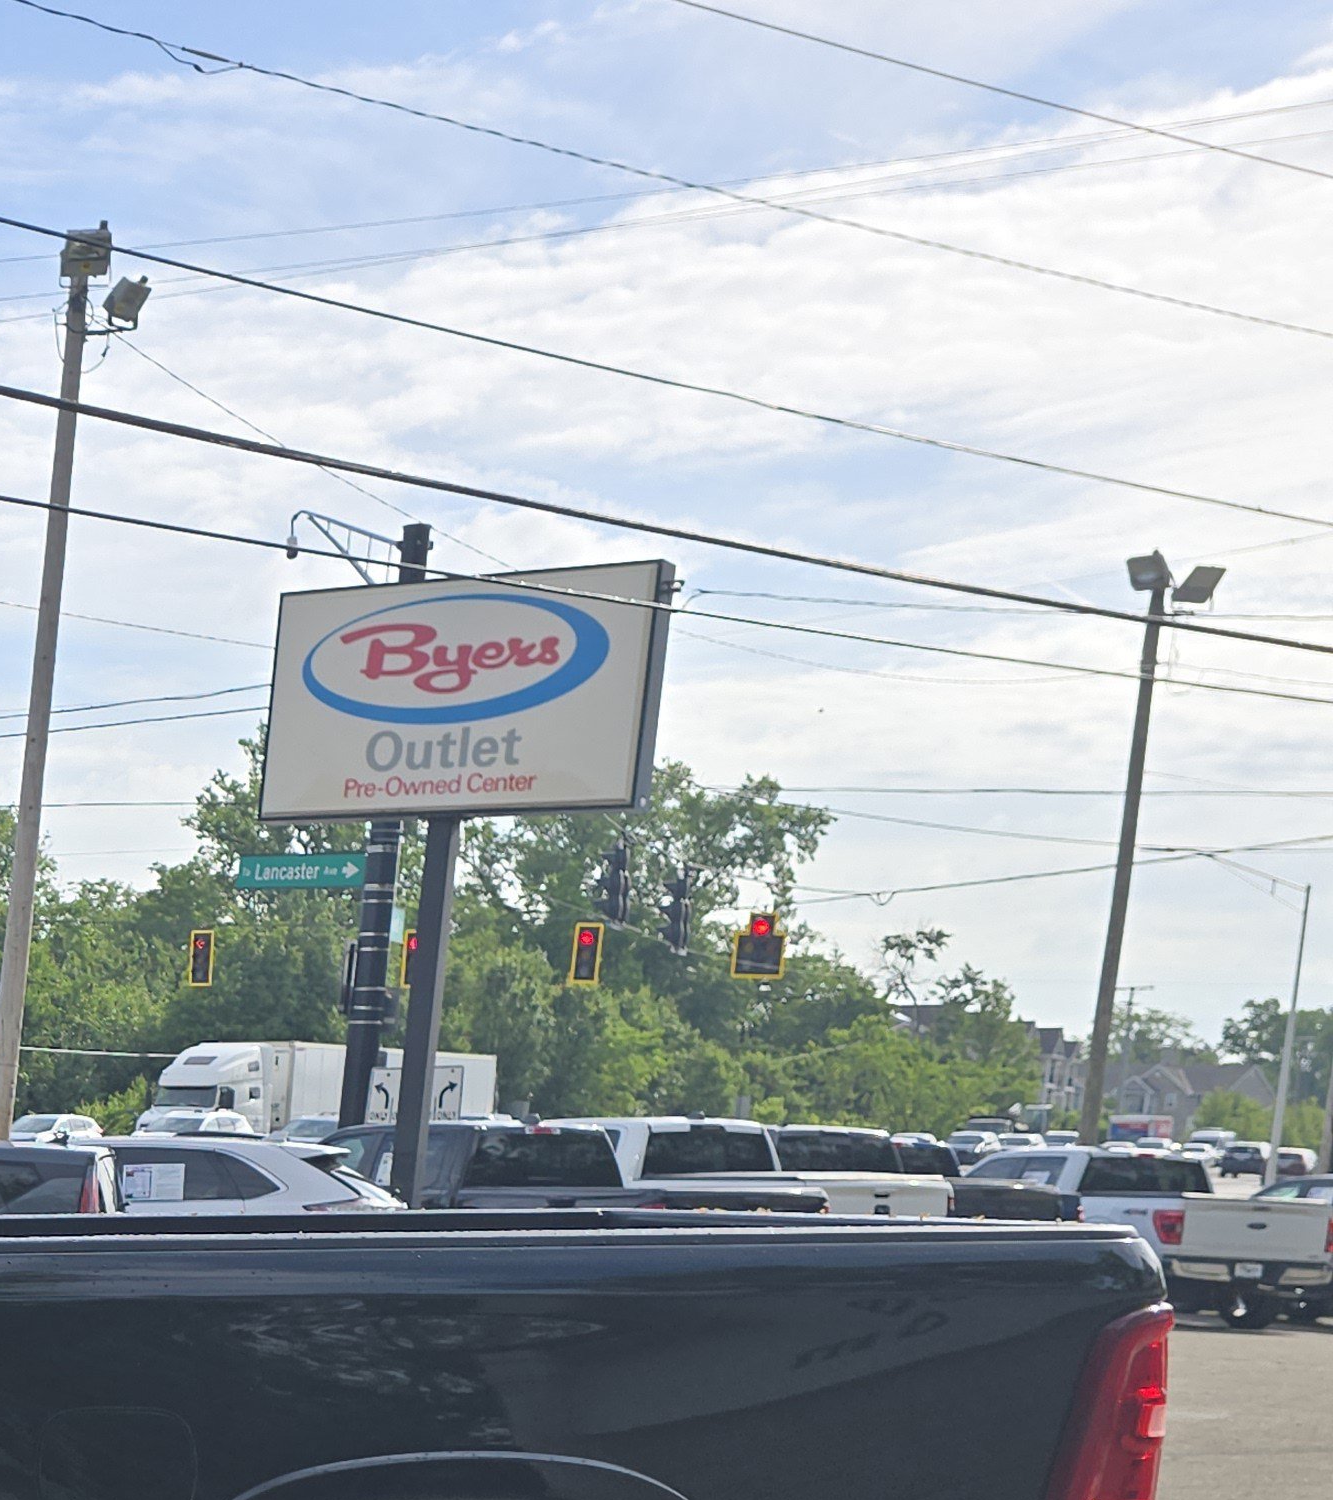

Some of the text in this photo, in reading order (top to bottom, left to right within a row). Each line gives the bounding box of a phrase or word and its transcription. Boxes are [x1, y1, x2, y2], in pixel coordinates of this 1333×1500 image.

[340, 622, 561, 694] Byers
[365, 727, 523, 773] Outlet
[343, 772, 538, 798] Pre-Owned Center
[254, 863, 320, 881] Lancaster
